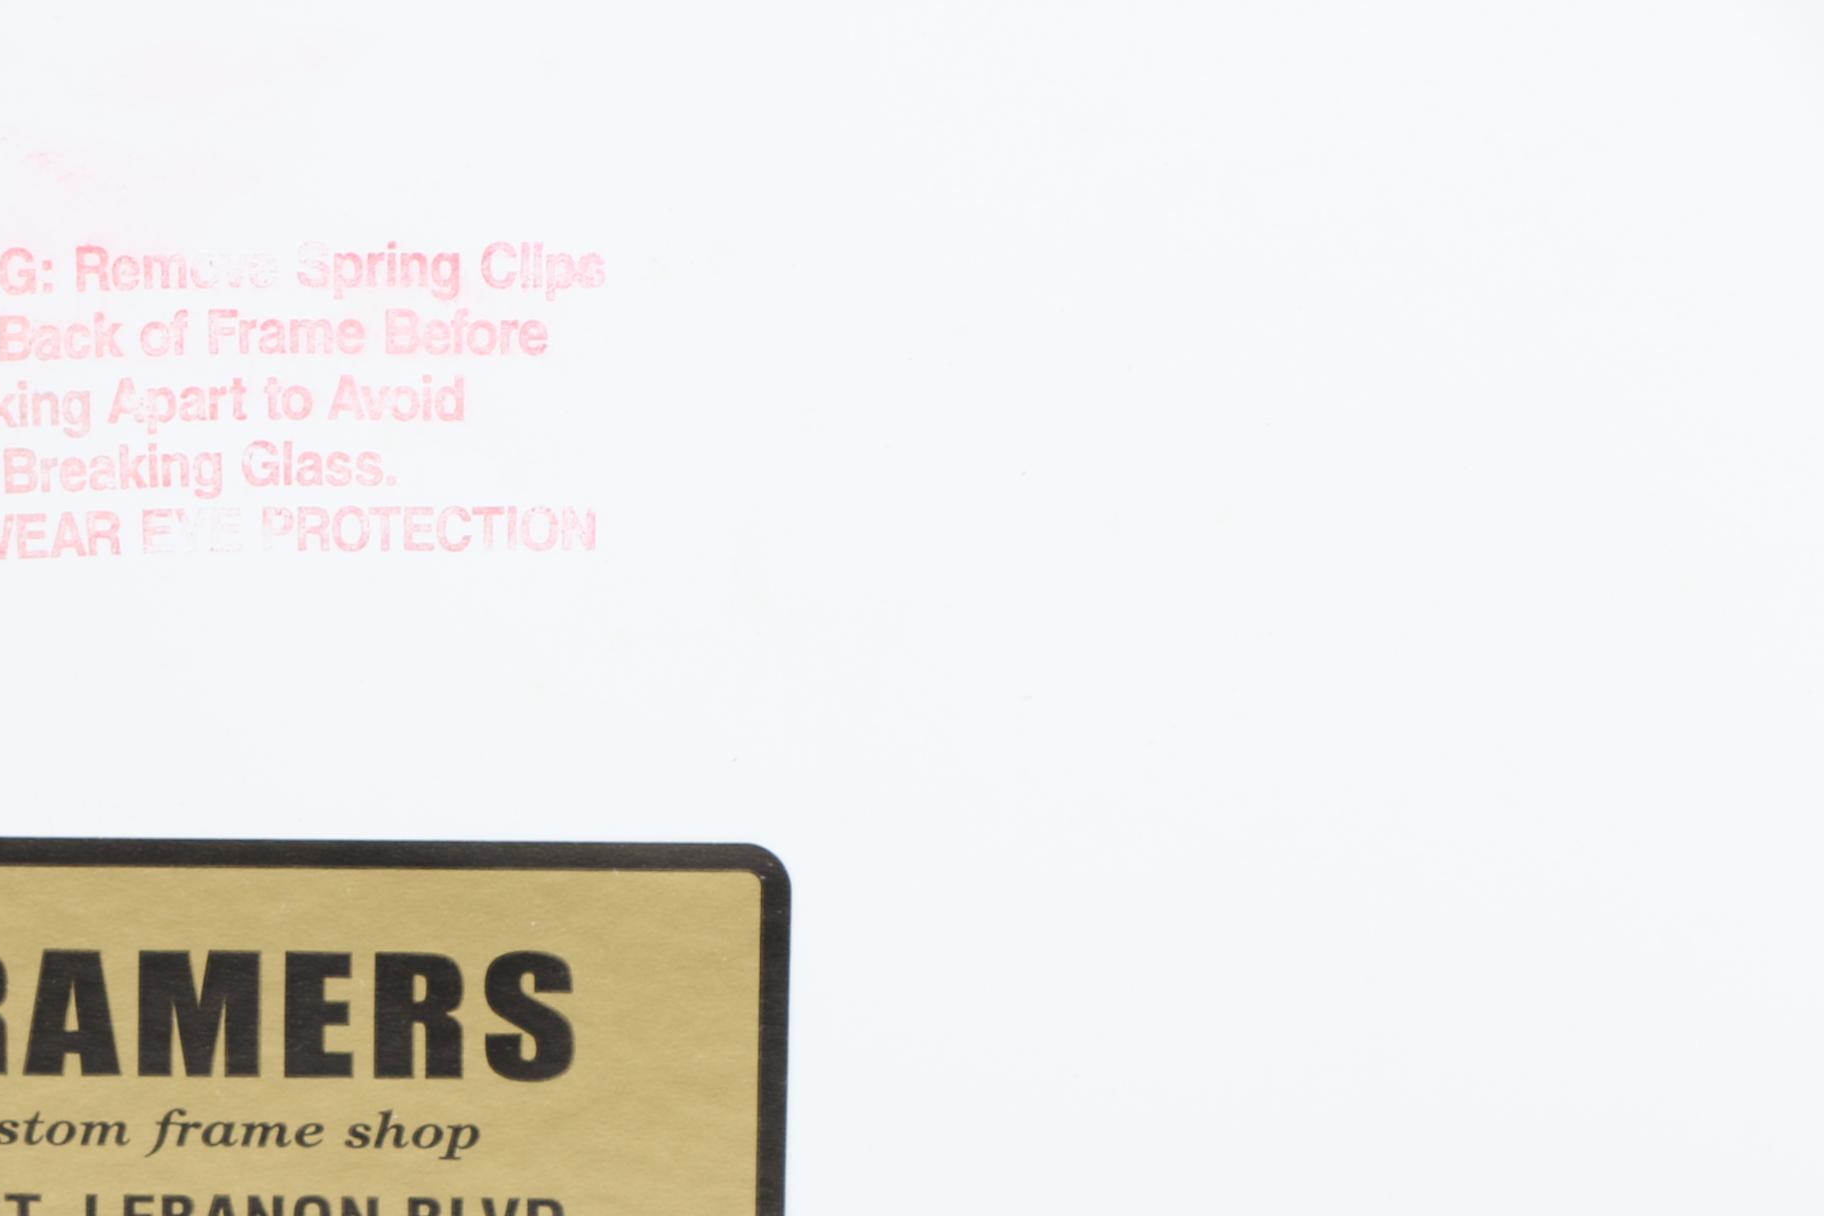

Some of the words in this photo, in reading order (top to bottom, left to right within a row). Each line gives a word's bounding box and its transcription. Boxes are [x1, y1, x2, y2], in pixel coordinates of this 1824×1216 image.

[297, 241, 460, 301] Spring
[481, 242, 604, 301] Clips
[140, 309, 188, 357] of
[208, 309, 364, 354] Frame
[386, 309, 548, 356] Before
[108, 378, 247, 431] Apart
[265, 378, 313, 420] to
[329, 375, 464, 421] Avoid
[4, 443, 222, 499] Breaking
[242, 440, 395, 487] Glass.
[263, 506, 596, 552] PROTECTION
[145, 1109, 324, 1157] frame
[345, 1111, 479, 1160] shop
